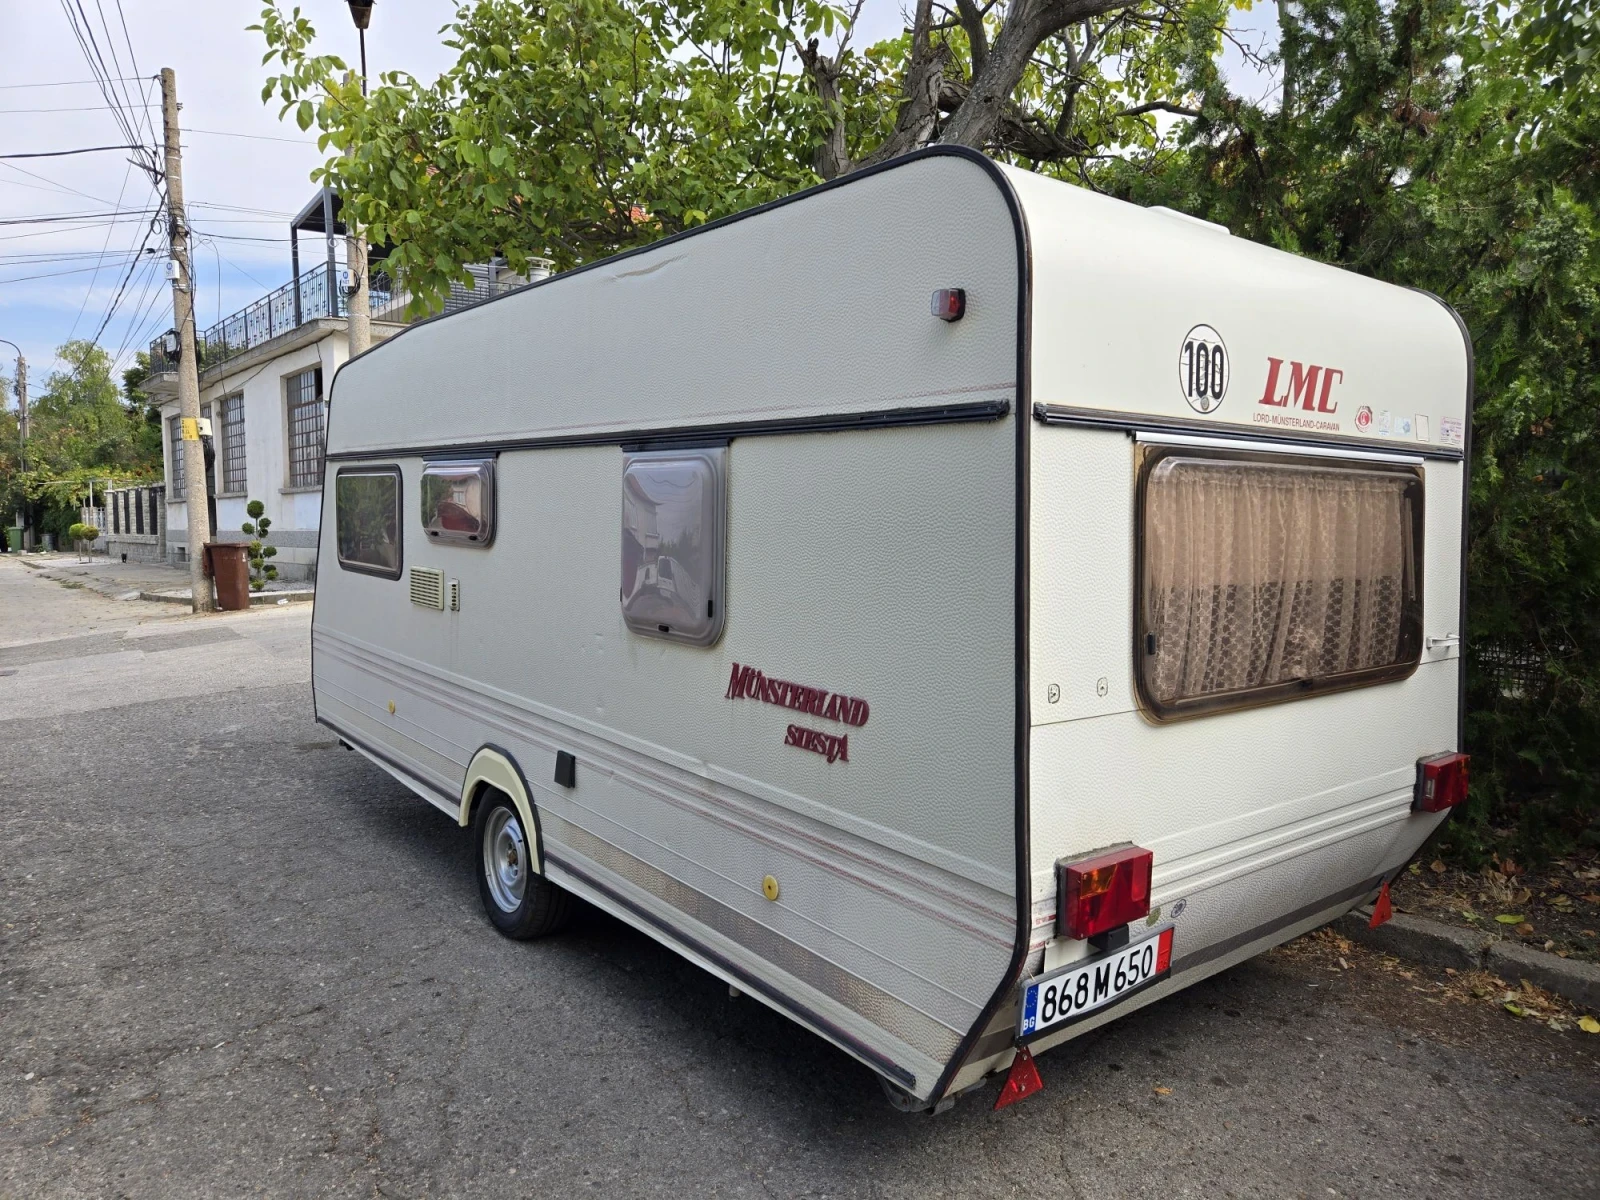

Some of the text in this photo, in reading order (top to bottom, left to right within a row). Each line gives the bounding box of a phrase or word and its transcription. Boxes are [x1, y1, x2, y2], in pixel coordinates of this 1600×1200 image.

[1184, 340, 1224, 400] 100
[1258, 356, 1343, 414] LMC
[724, 662, 870, 727] MÜNSTERLAND
[1024, 1016, 1035, 1030] BG
